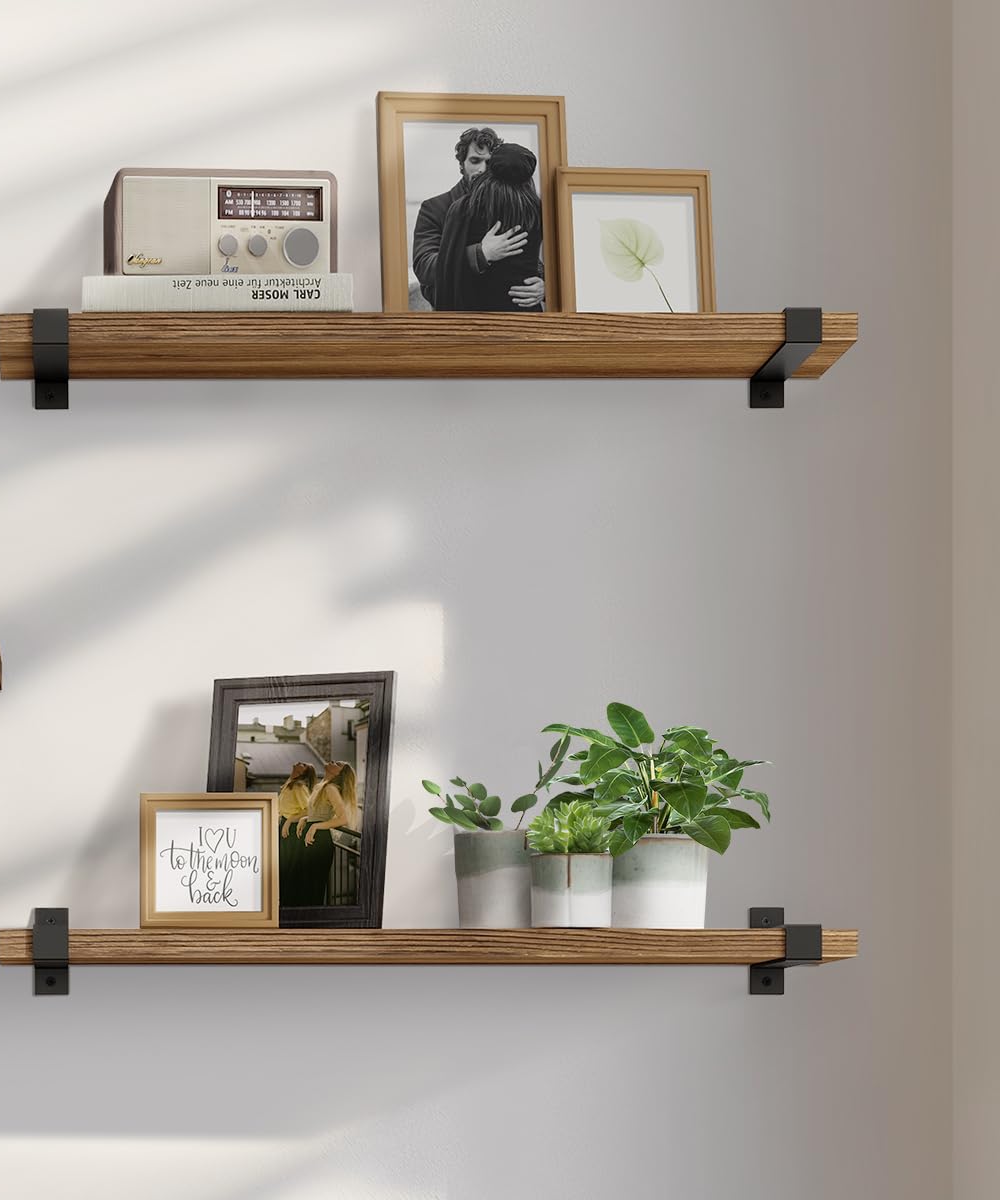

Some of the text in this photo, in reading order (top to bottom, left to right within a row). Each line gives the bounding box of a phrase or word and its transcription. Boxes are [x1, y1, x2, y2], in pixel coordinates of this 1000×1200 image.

[172, 280, 191, 289] Zeit
[222, 279, 244, 287] eine
[247, 278, 262, 288] für
[265, 278, 322, 288] Architektur
[252, 290, 320, 299] CARL MOSER
[226, 828, 236, 848] U
[190, 842, 214, 873] the
[215, 851, 259, 874] moon
[206, 870, 221, 892] &
[181, 869, 238, 907] back
